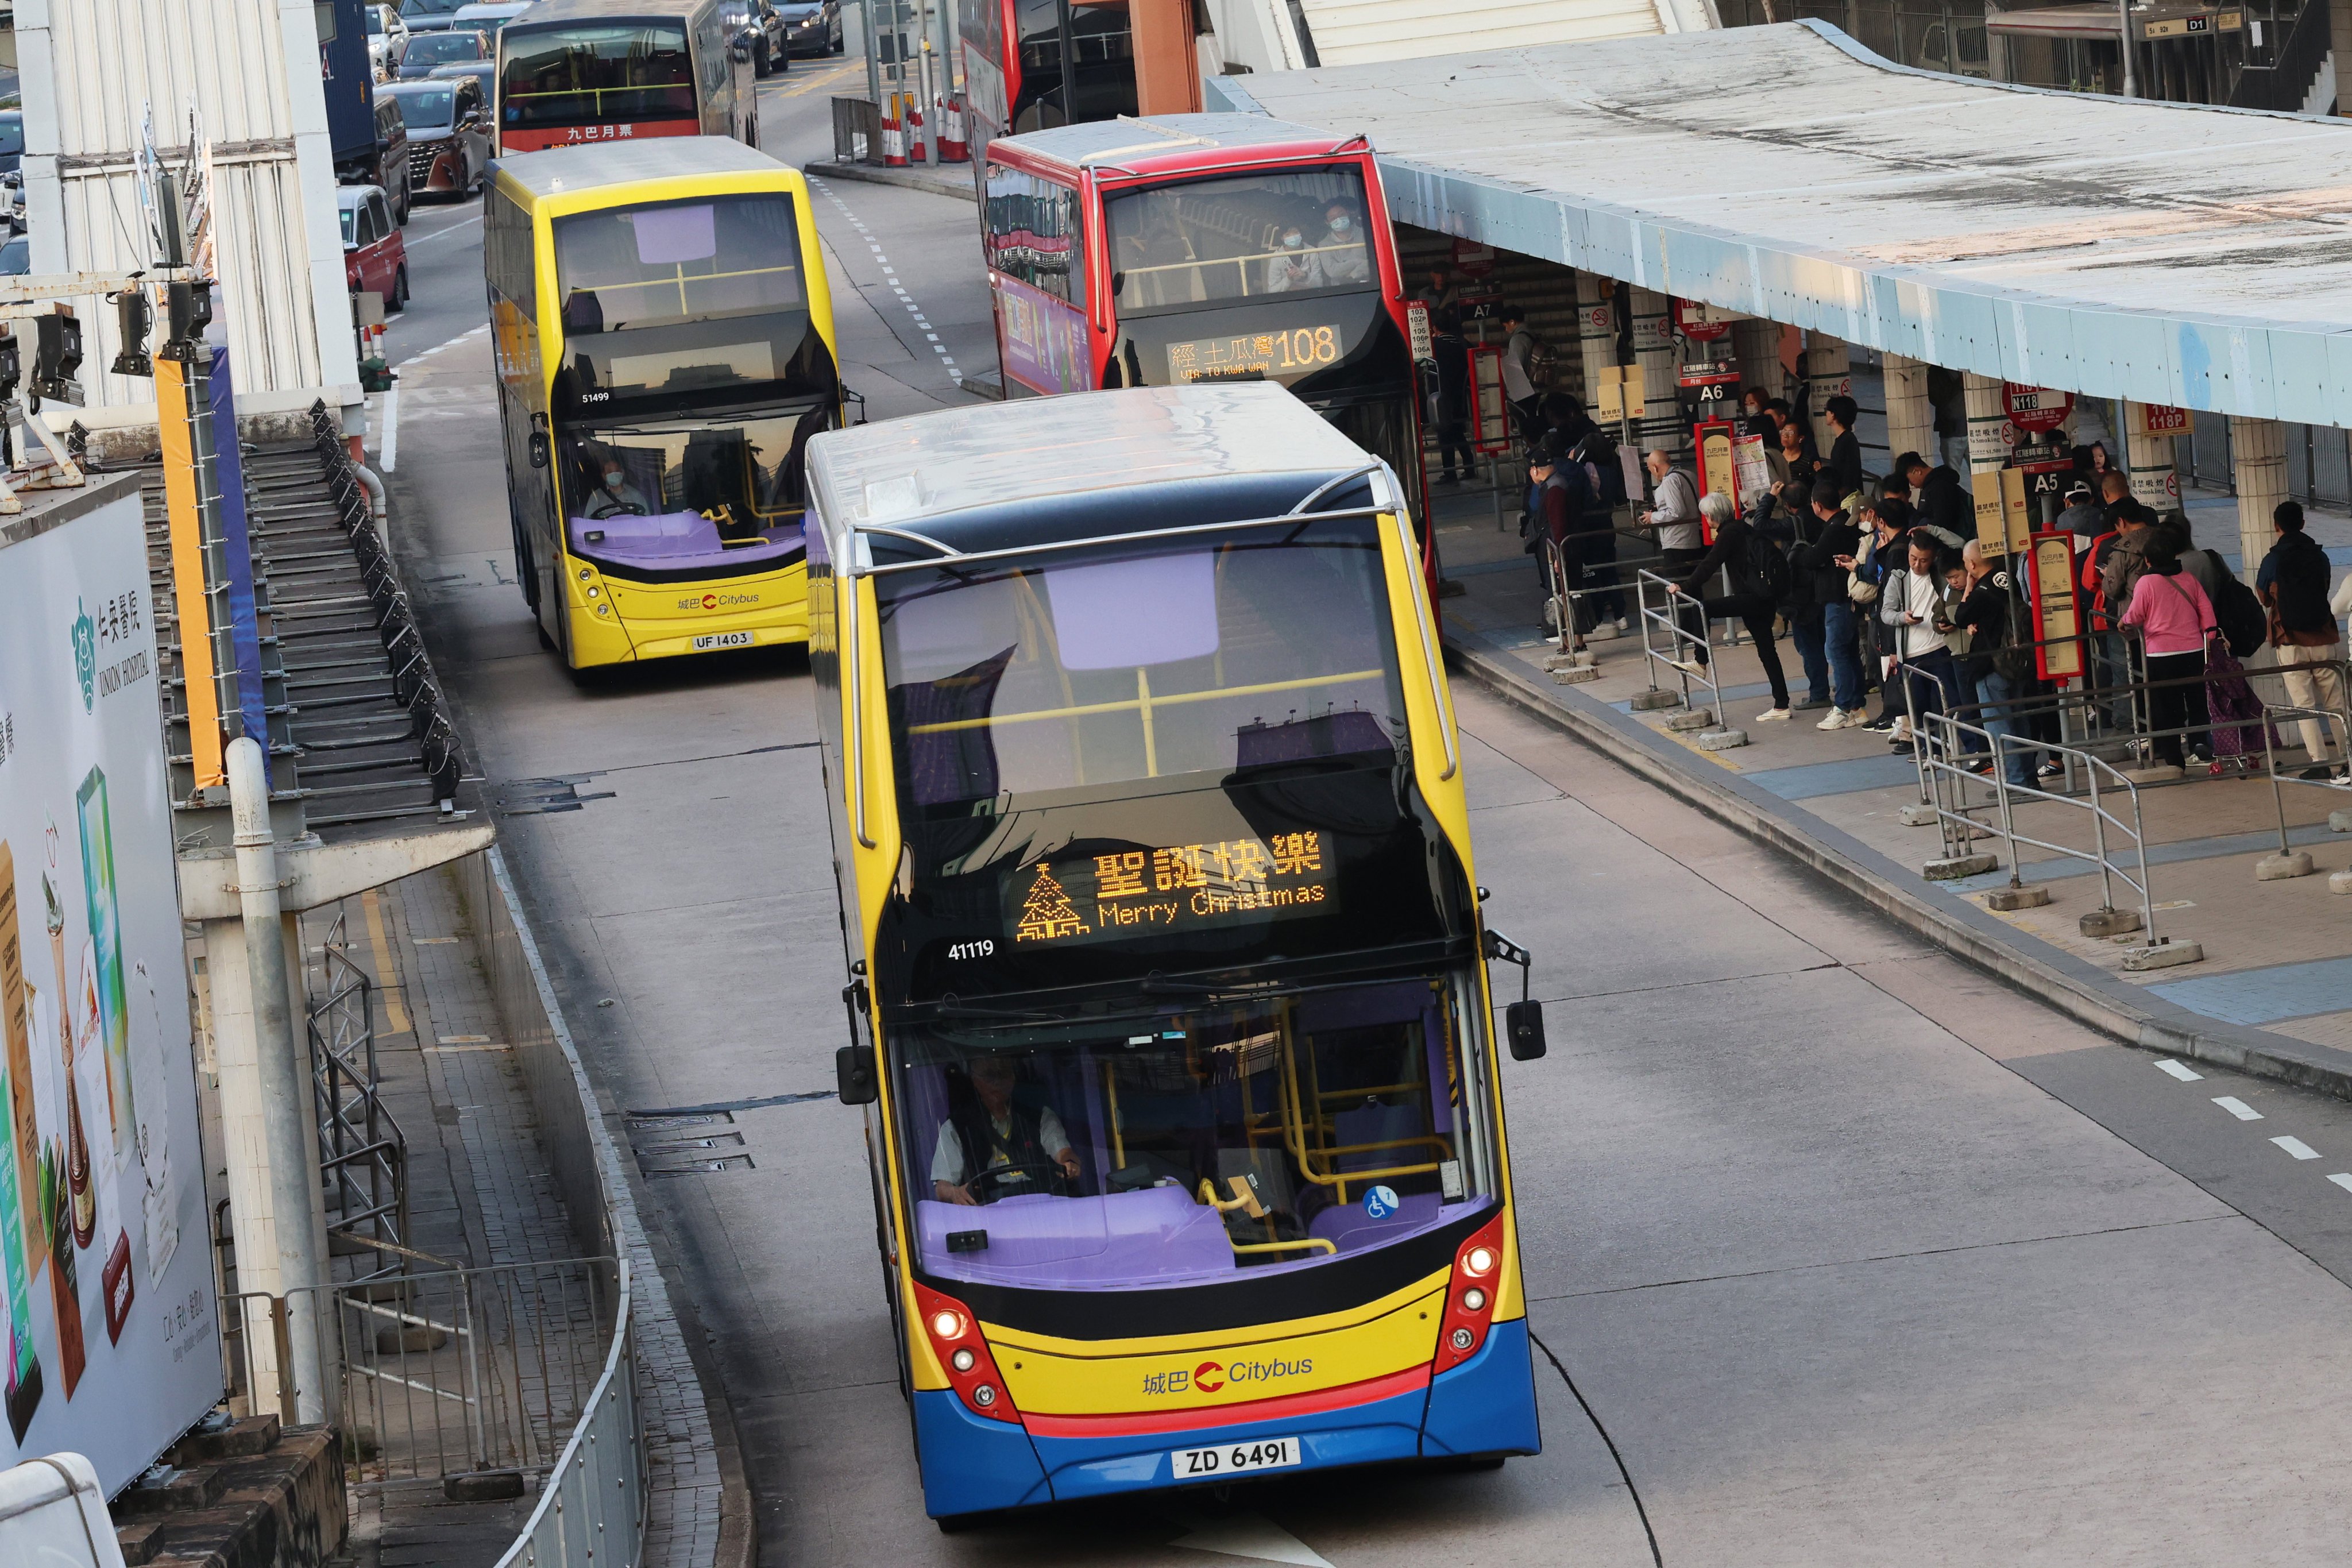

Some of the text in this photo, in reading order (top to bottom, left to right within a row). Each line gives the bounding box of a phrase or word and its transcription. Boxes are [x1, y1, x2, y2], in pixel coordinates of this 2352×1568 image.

[2190, 20, 2203, 29] D1
[567, 124, 632, 140] 九巴月票
[1474, 304, 1490, 318] A7
[1276, 326, 1336, 367] 108
[1180, 361, 1269, 379] VIA: TO KWA WAN
[582, 392, 609, 403] 51499
[1700, 384, 1723, 401] A6
[2012, 395, 2038, 411] N118
[2150, 414, 2183, 429] 118P
[2015, 446, 2050, 458] 紅隧轉車站
[2034, 473, 2058, 492] A5
[2138, 488, 2165, 496] Smoking
[2041, 553, 2064, 561] 九巴月票
[677, 598, 700, 609] 城巴
[719, 594, 759, 605] Citybus
[98, 590, 140, 649] 仁安醫院
[697, 633, 747, 648] UF 1403
[99, 650, 149, 698] UNION HOSPITAL
[1093, 831, 1322, 898] 聖誕快樂
[1098, 885, 1324, 927] Merry Christmas
[948, 939, 994, 960] 41119
[1385, 1191, 1390, 1200] 1
[1229, 1358, 1312, 1382] Citybus
[1142, 1370, 1189, 1396] 城巴
[1186, 1442, 1287, 1473] ZD 6491
